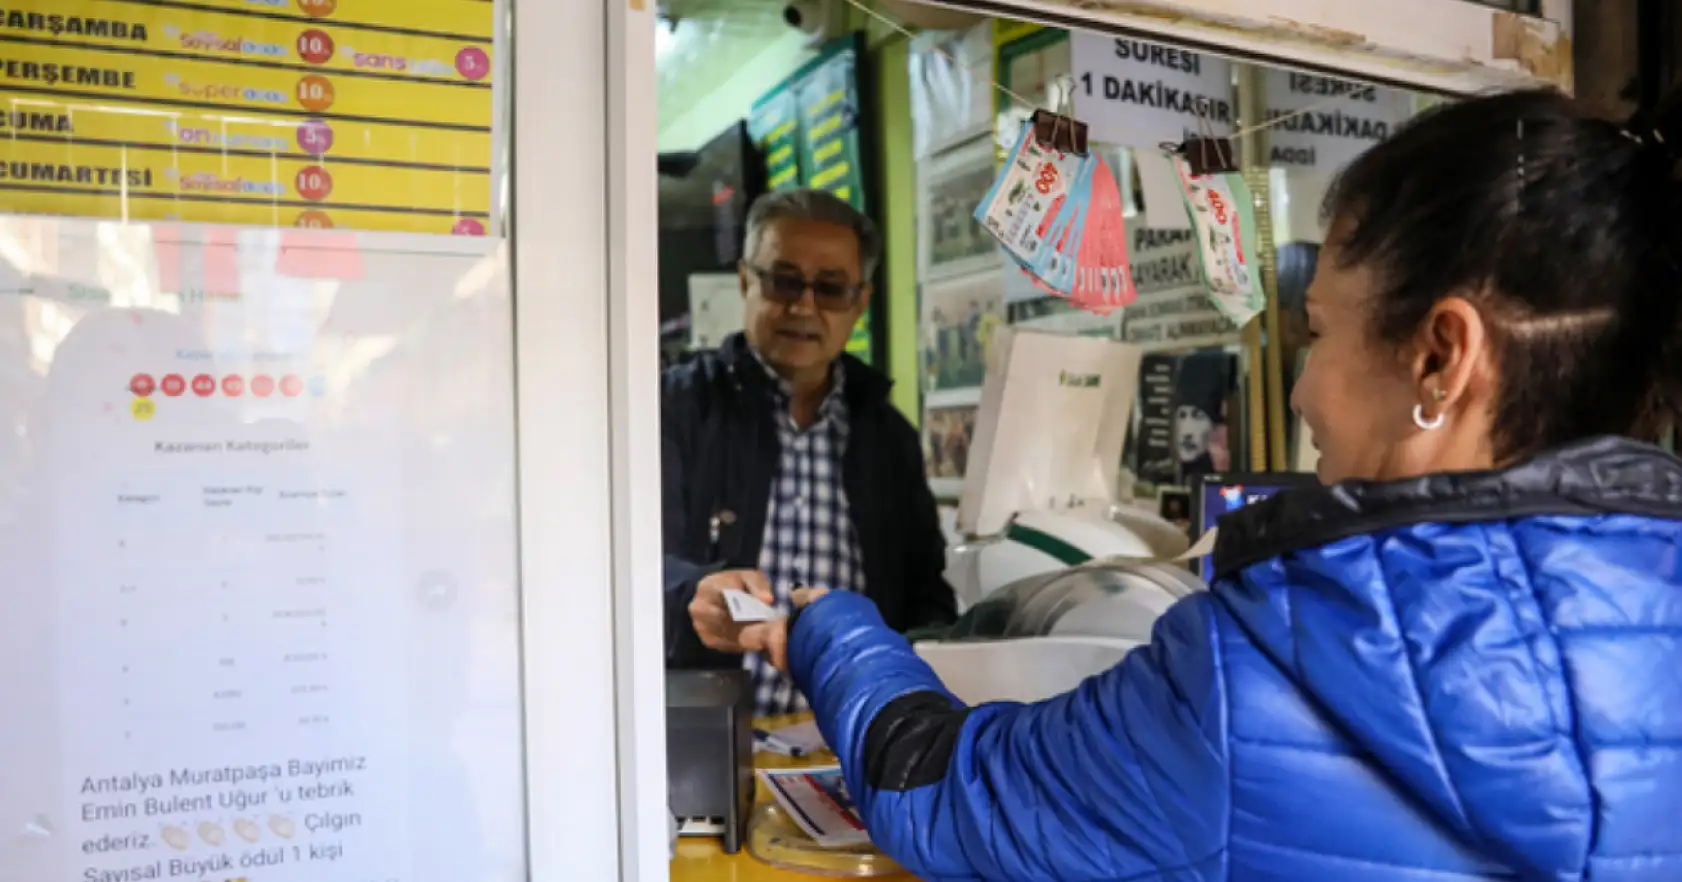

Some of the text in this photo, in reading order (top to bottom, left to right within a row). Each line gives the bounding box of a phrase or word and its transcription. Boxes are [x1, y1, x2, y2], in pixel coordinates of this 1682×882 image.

[0, 9, 147, 41] ARŞAMBA
[0, 58, 136, 89] ERŞEMBE
[1081, 71, 1231, 124] 1 DAKİKADIR
[81, 771, 163, 794] Antalya
[170, 761, 282, 787] Muratpaşa
[81, 800, 138, 822] Emin
[219, 790, 268, 811] Uğur
[298, 779, 355, 801] tebrik
[304, 811, 362, 835] Çılgın
[83, 860, 162, 882] Sayısal
[309, 839, 344, 862] kişi
